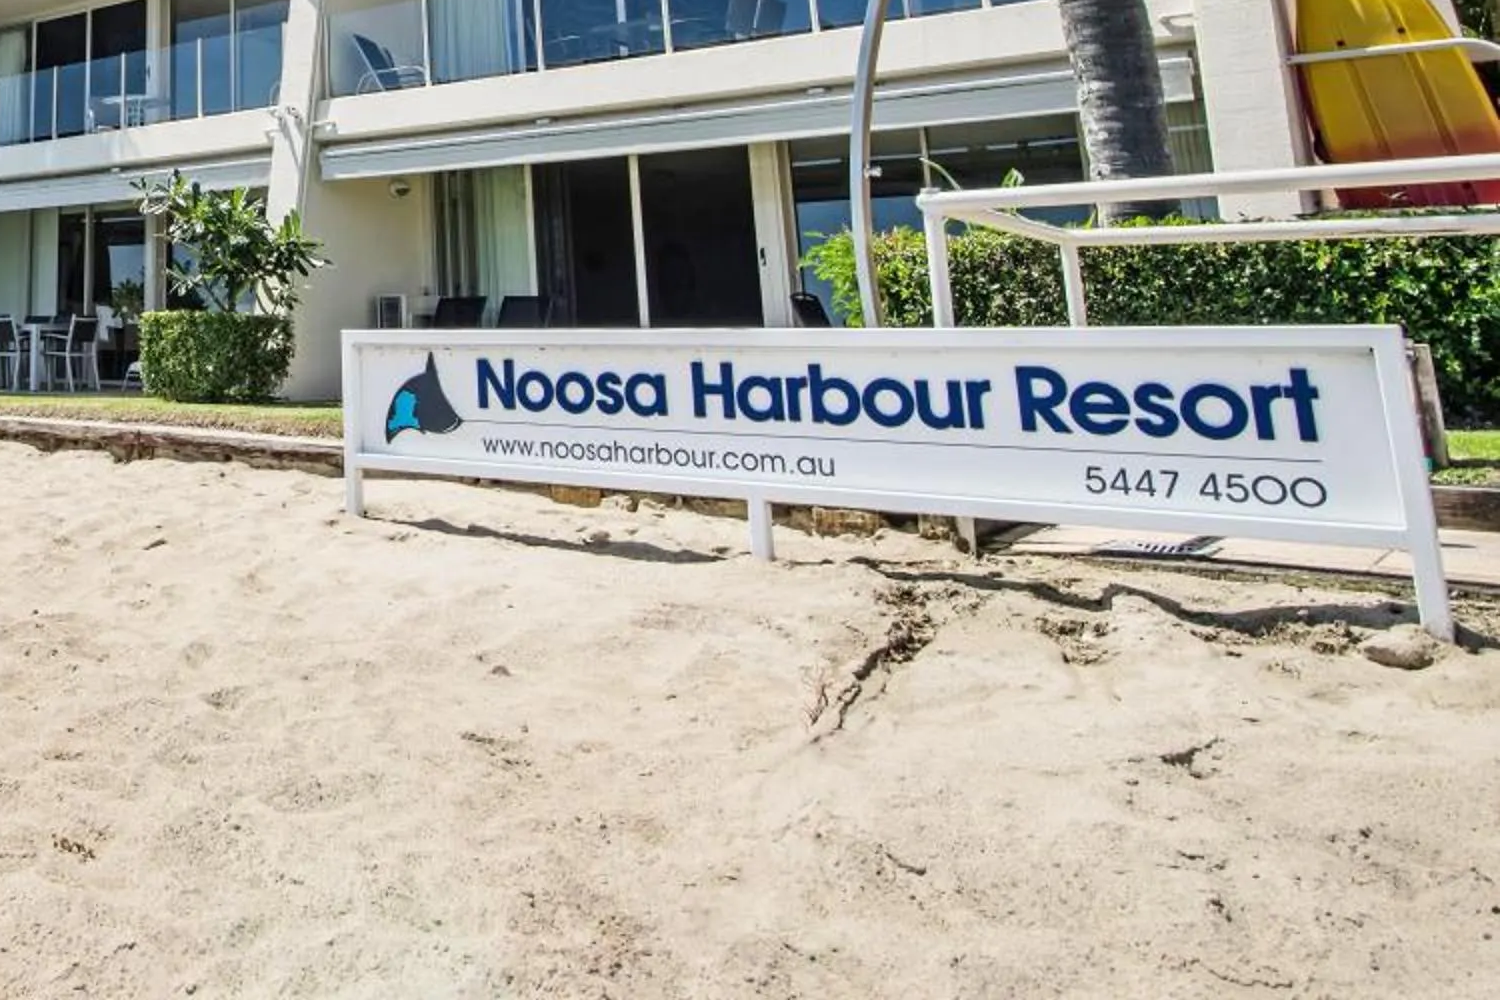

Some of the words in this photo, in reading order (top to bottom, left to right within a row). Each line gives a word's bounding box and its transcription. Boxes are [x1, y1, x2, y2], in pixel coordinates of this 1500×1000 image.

[476, 357, 669, 418] Noosa
[690, 361, 992, 431] Harbour
[1014, 365, 1320, 443] Resort
[481, 436, 837, 477] www.noosaharbour.com.au
[1085, 466, 1180, 498] 5447
[1199, 472, 1328, 507] 4500
